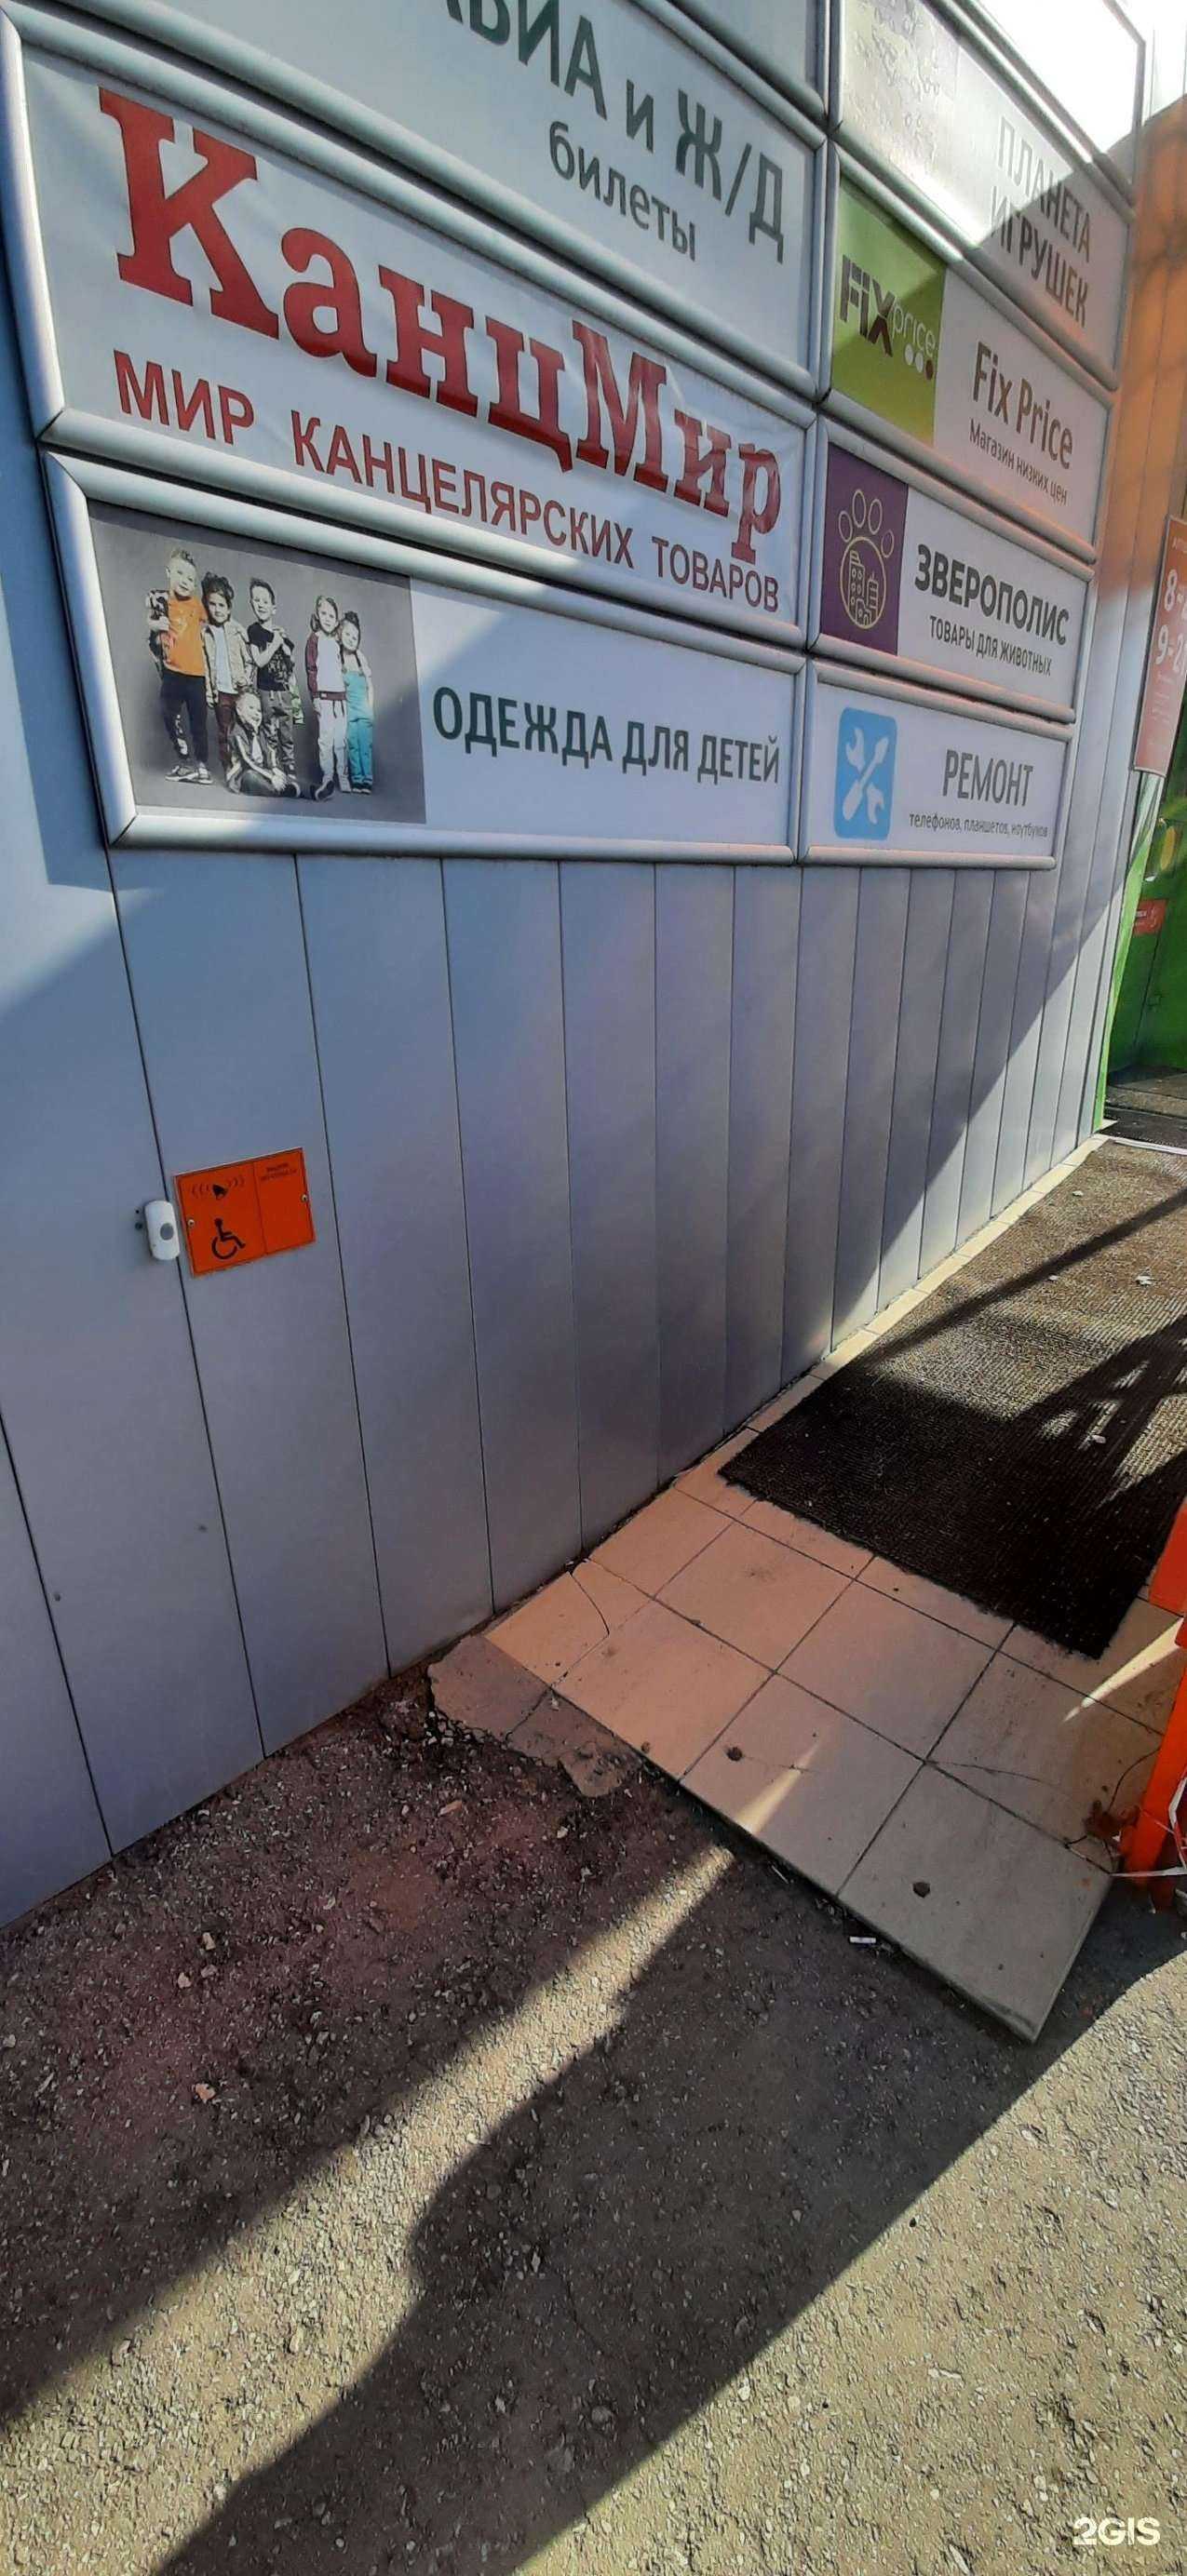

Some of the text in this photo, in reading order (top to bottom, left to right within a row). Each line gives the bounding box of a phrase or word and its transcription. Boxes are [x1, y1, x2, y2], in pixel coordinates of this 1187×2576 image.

[447, 0, 607, 121] ИА
[676, 87, 784, 265] Ж/Д
[549, 120, 696, 262] билеты
[998, 115, 1090, 263] ПЛАНЕТА
[98, 86, 781, 564] КанцМир
[969, 417, 1068, 506] Магазин низких цен
[972, 341, 1073, 470] Fix Price
[114, 349, 780, 613] МИР КАНЦЕЛЯРСКИХ ТОВАРОВ
[914, 543, 1070, 646] ЗВЕРОПОЛИС
[929, 614, 1053, 677] ТОВАРЫ ДЛЯ ЖИВОТНЫХ
[432, 686, 780, 785] ОДЕЖДА ДЛЯ ДЕТЕЙ
[942, 748, 1034, 807] РЕМОНТ
